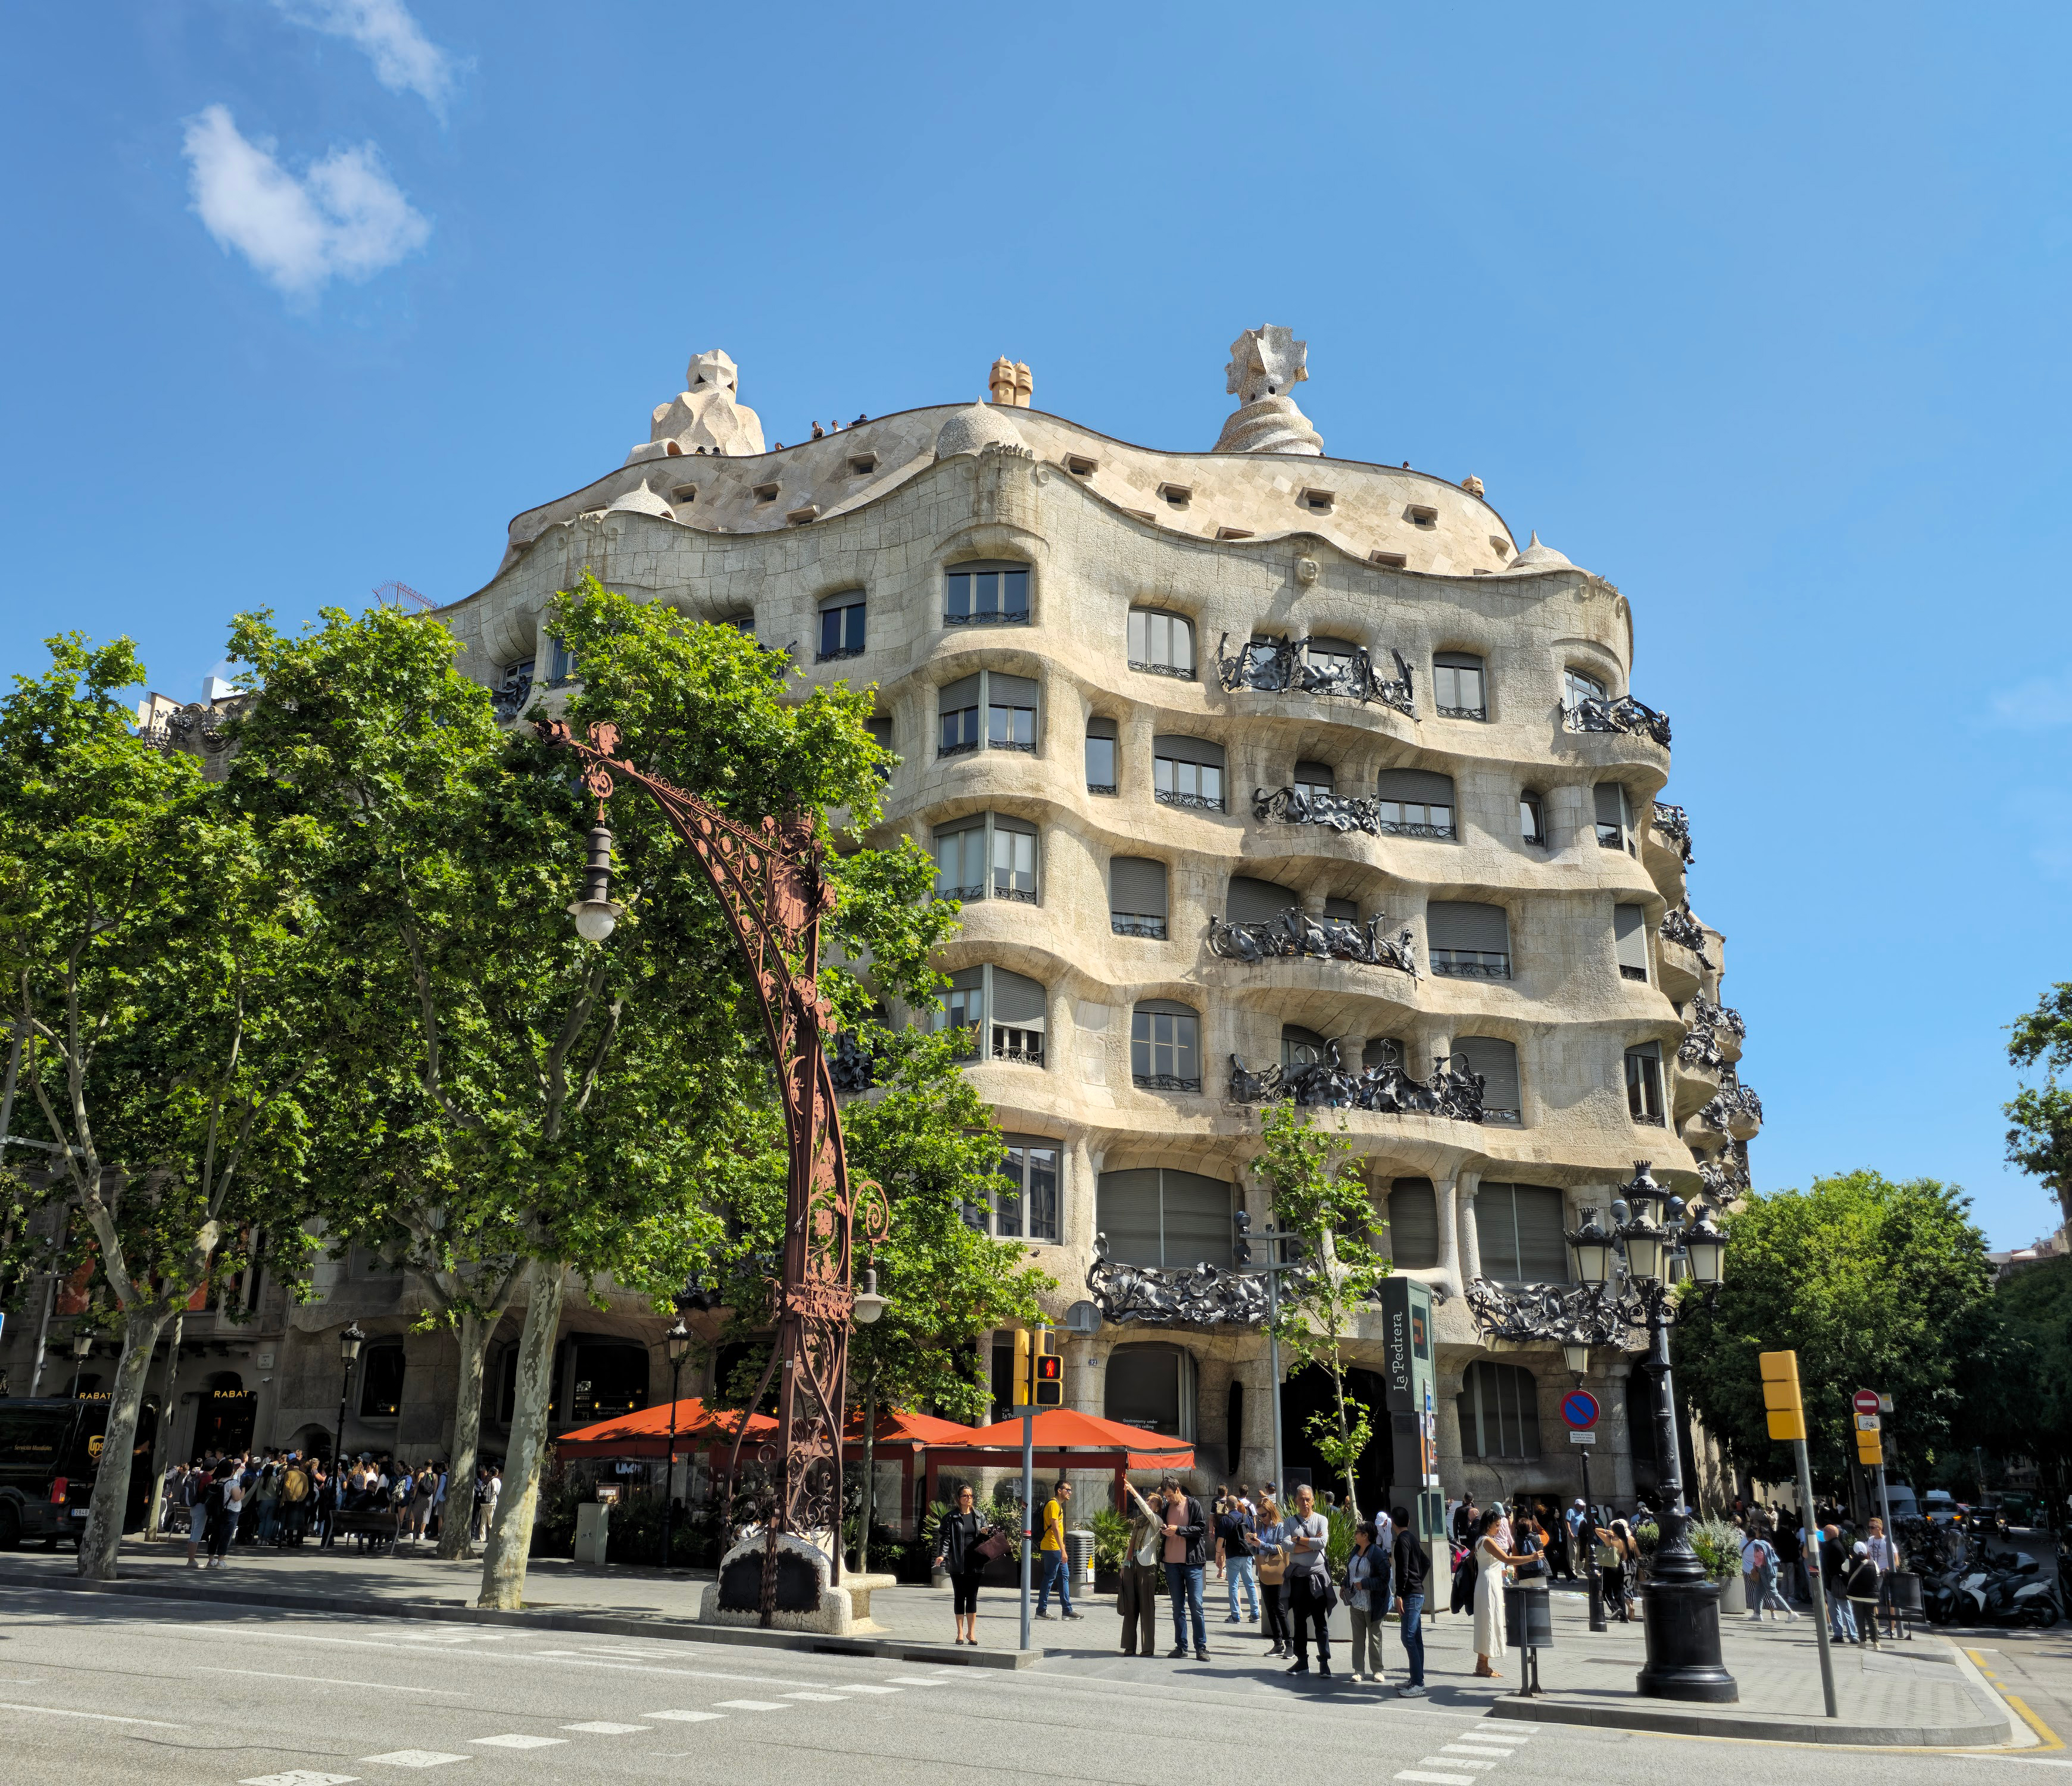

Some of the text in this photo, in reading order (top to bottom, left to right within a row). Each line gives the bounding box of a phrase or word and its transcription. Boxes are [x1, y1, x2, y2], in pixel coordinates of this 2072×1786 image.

[1391, 1312, 1408, 1391] La Pedrera
[90, 1442, 104, 1454] ups
